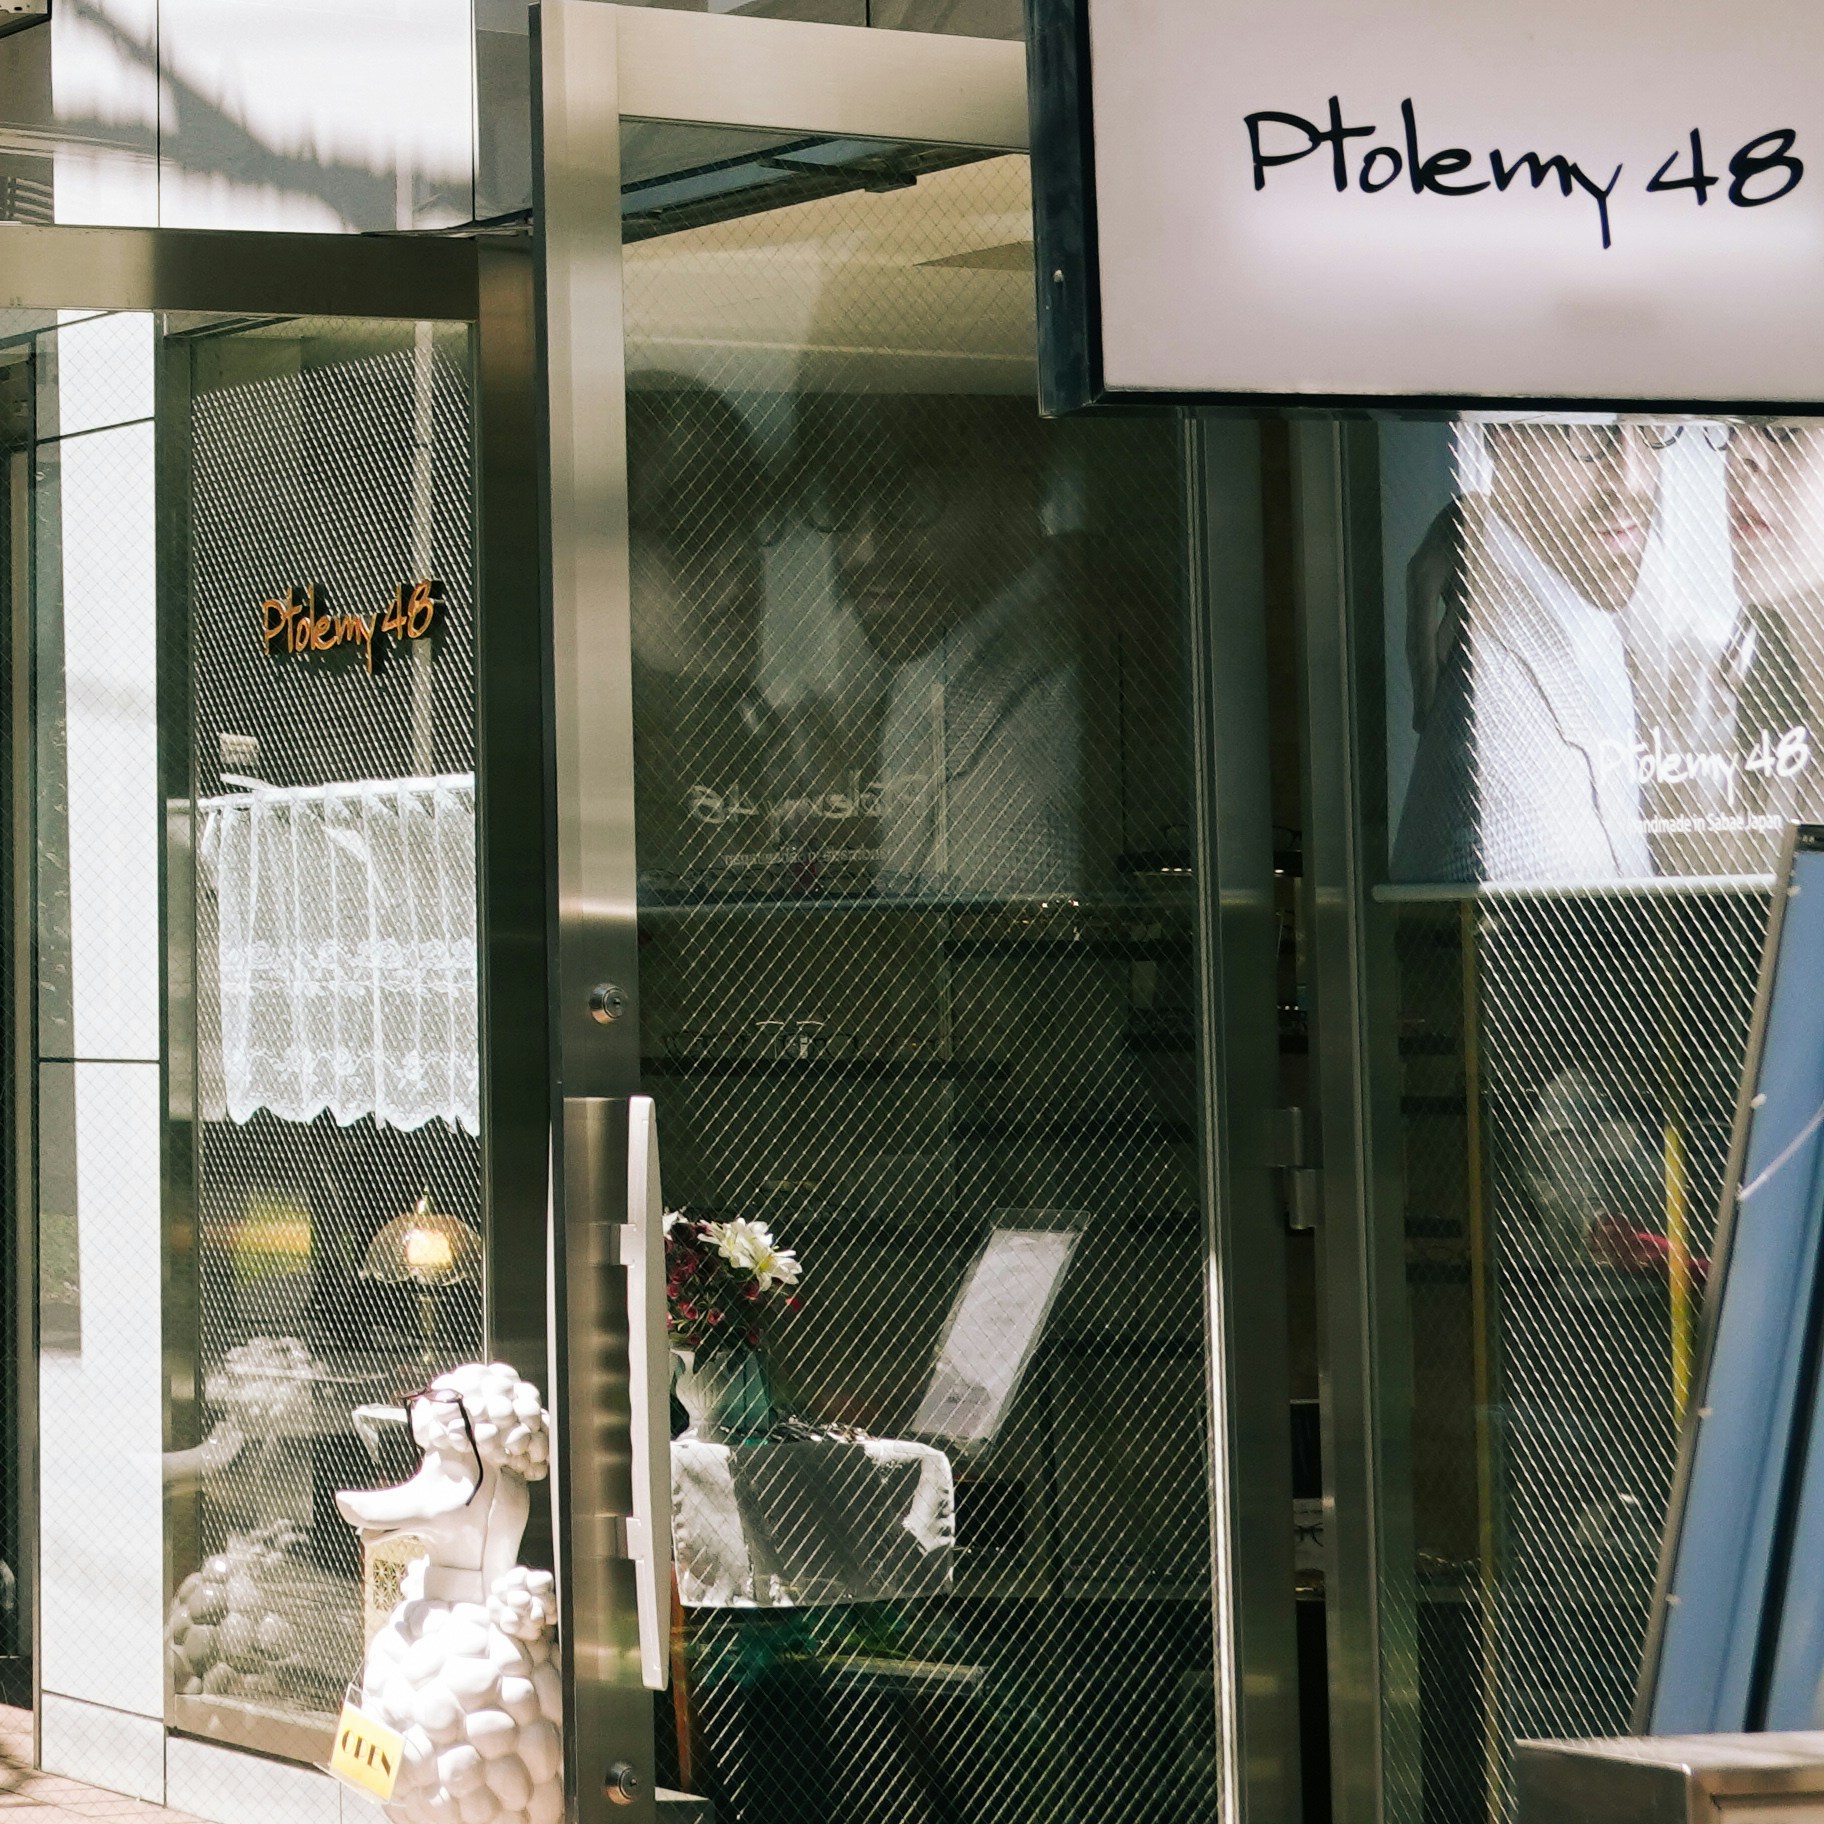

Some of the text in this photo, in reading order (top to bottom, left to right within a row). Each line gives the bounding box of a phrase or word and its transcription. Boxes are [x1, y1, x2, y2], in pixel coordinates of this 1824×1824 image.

[1244, 95, 1804, 250] Ptolemy 48
[262, 579, 435, 675] Ptolemy 48
[1745, 726, 1811, 778] 48
[342, 1729, 391, 1778] OPEN
